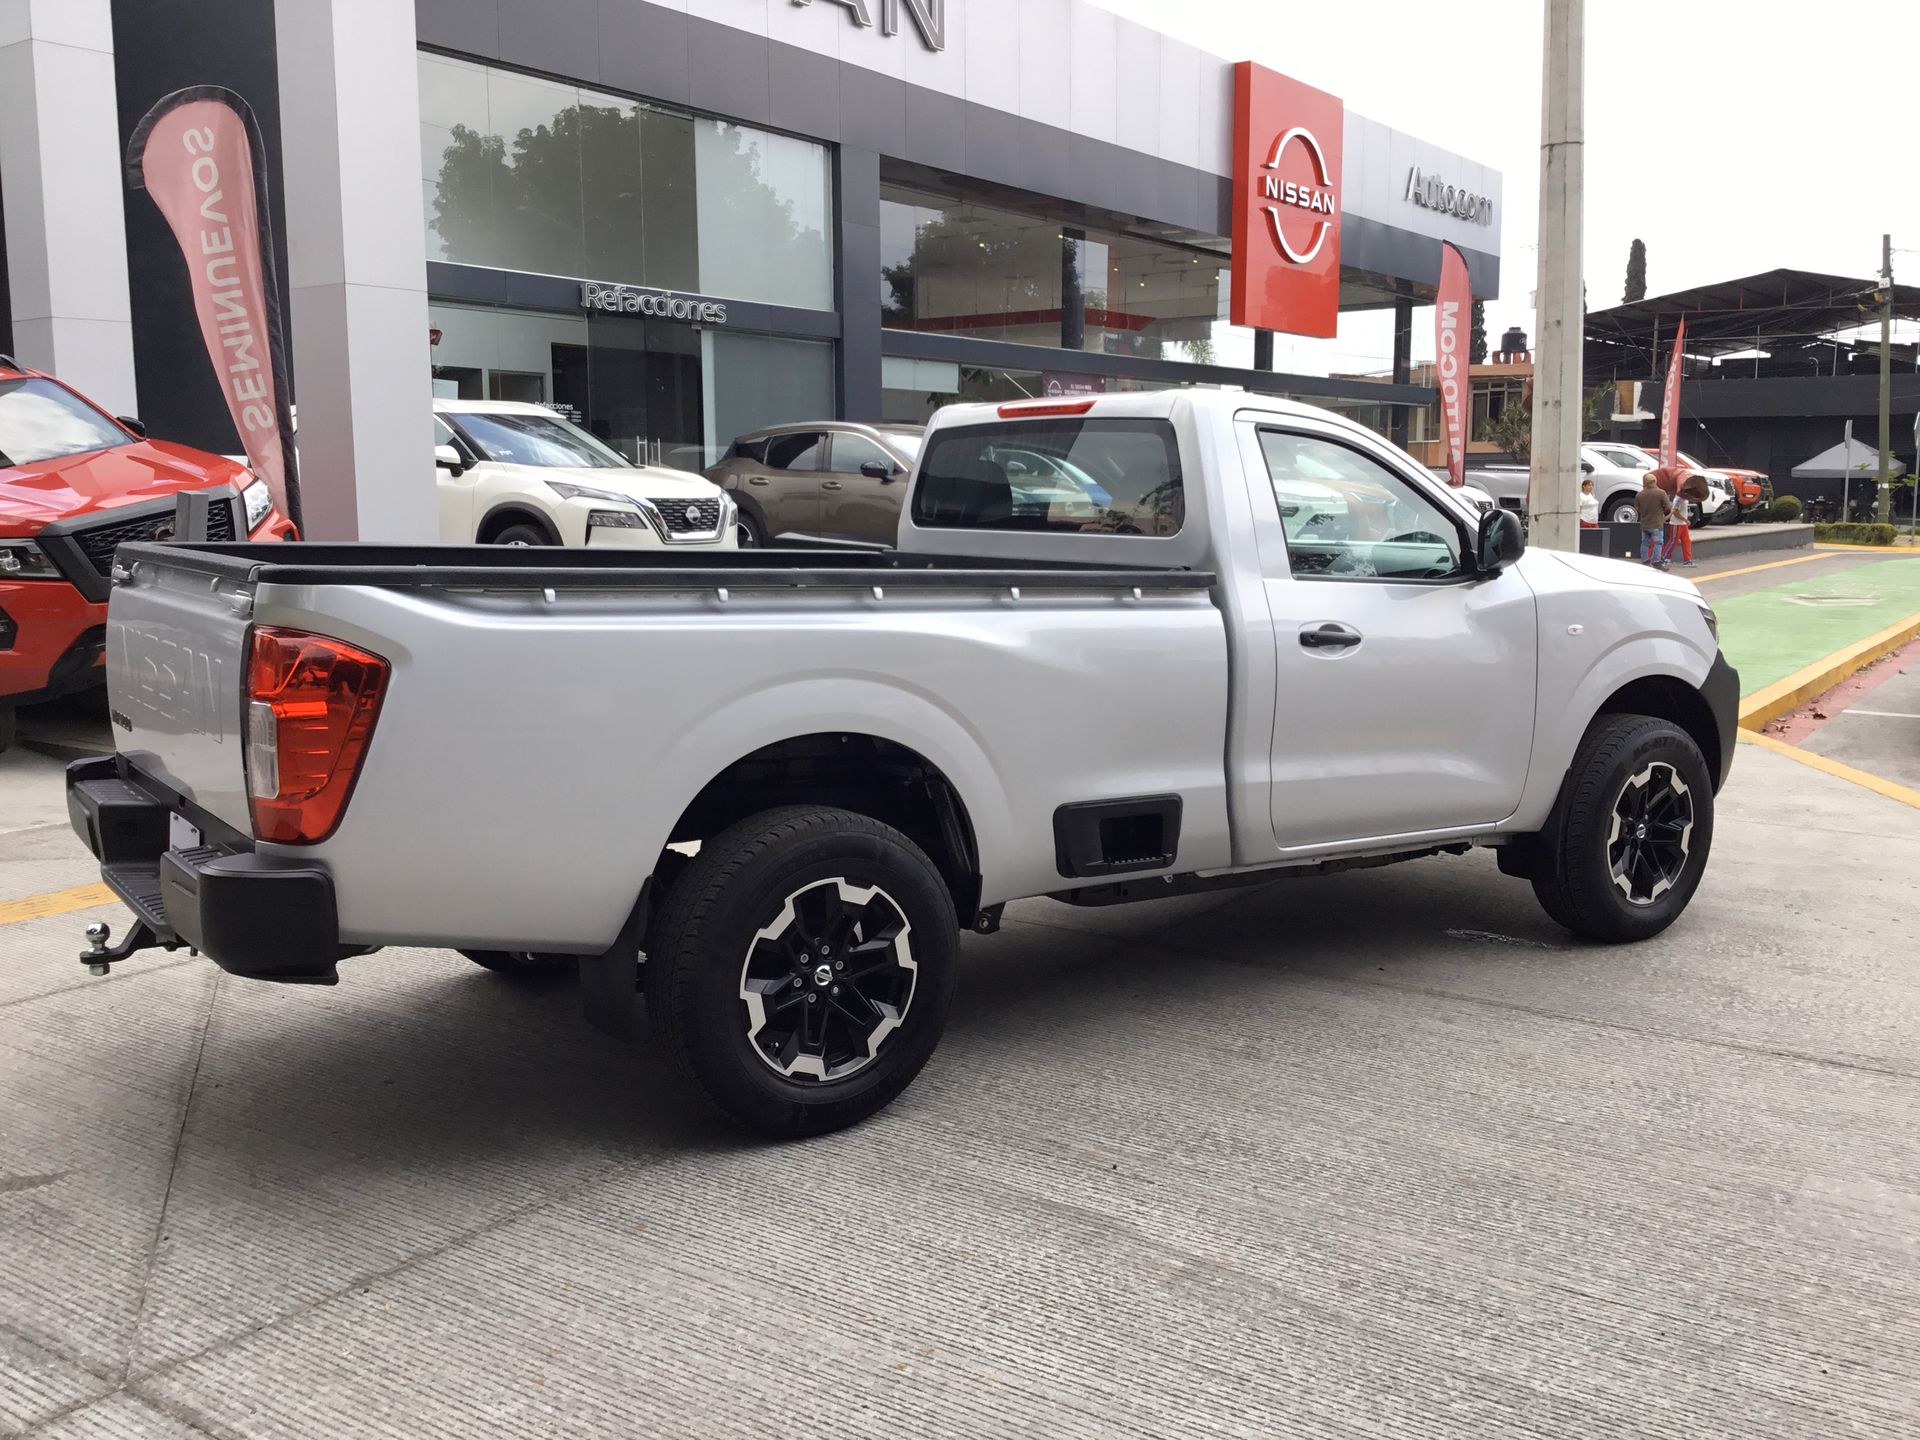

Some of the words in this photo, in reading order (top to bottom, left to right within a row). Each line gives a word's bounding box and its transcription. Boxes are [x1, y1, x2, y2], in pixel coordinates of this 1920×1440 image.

[1265, 174, 1335, 215] NISSAN
[1404, 166, 1492, 226] Autocom
[582, 282, 728, 323] Refacciones
